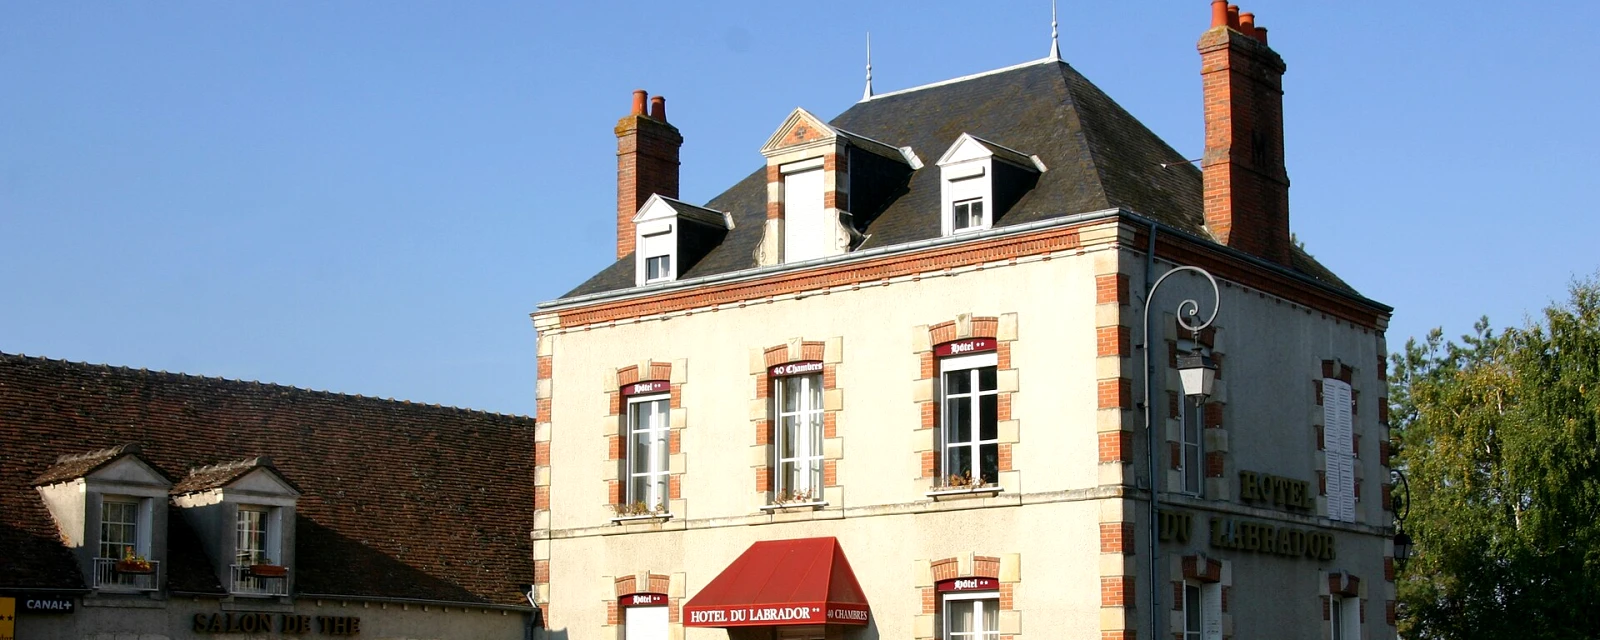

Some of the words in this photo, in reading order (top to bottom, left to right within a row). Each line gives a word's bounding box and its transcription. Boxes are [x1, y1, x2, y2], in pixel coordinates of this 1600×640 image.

[773, 367, 785, 375] 40
[786, 362, 823, 374] Chambres
[1240, 470, 1315, 511] HOTEL
[1158, 510, 1194, 543] DU
[1210, 516, 1337, 561] LABRADOR
[26, 599, 72, 610] CANAL+
[194, 612, 274, 634] SALON
[282, 614, 311, 634] DE
[690, 610, 728, 623] HOTEL
[730, 609, 747, 622] DU
[749, 606, 811, 621] LABRADOR
[827, 609, 834, 619] 40
[834, 609, 868, 621] CHAMBRES
